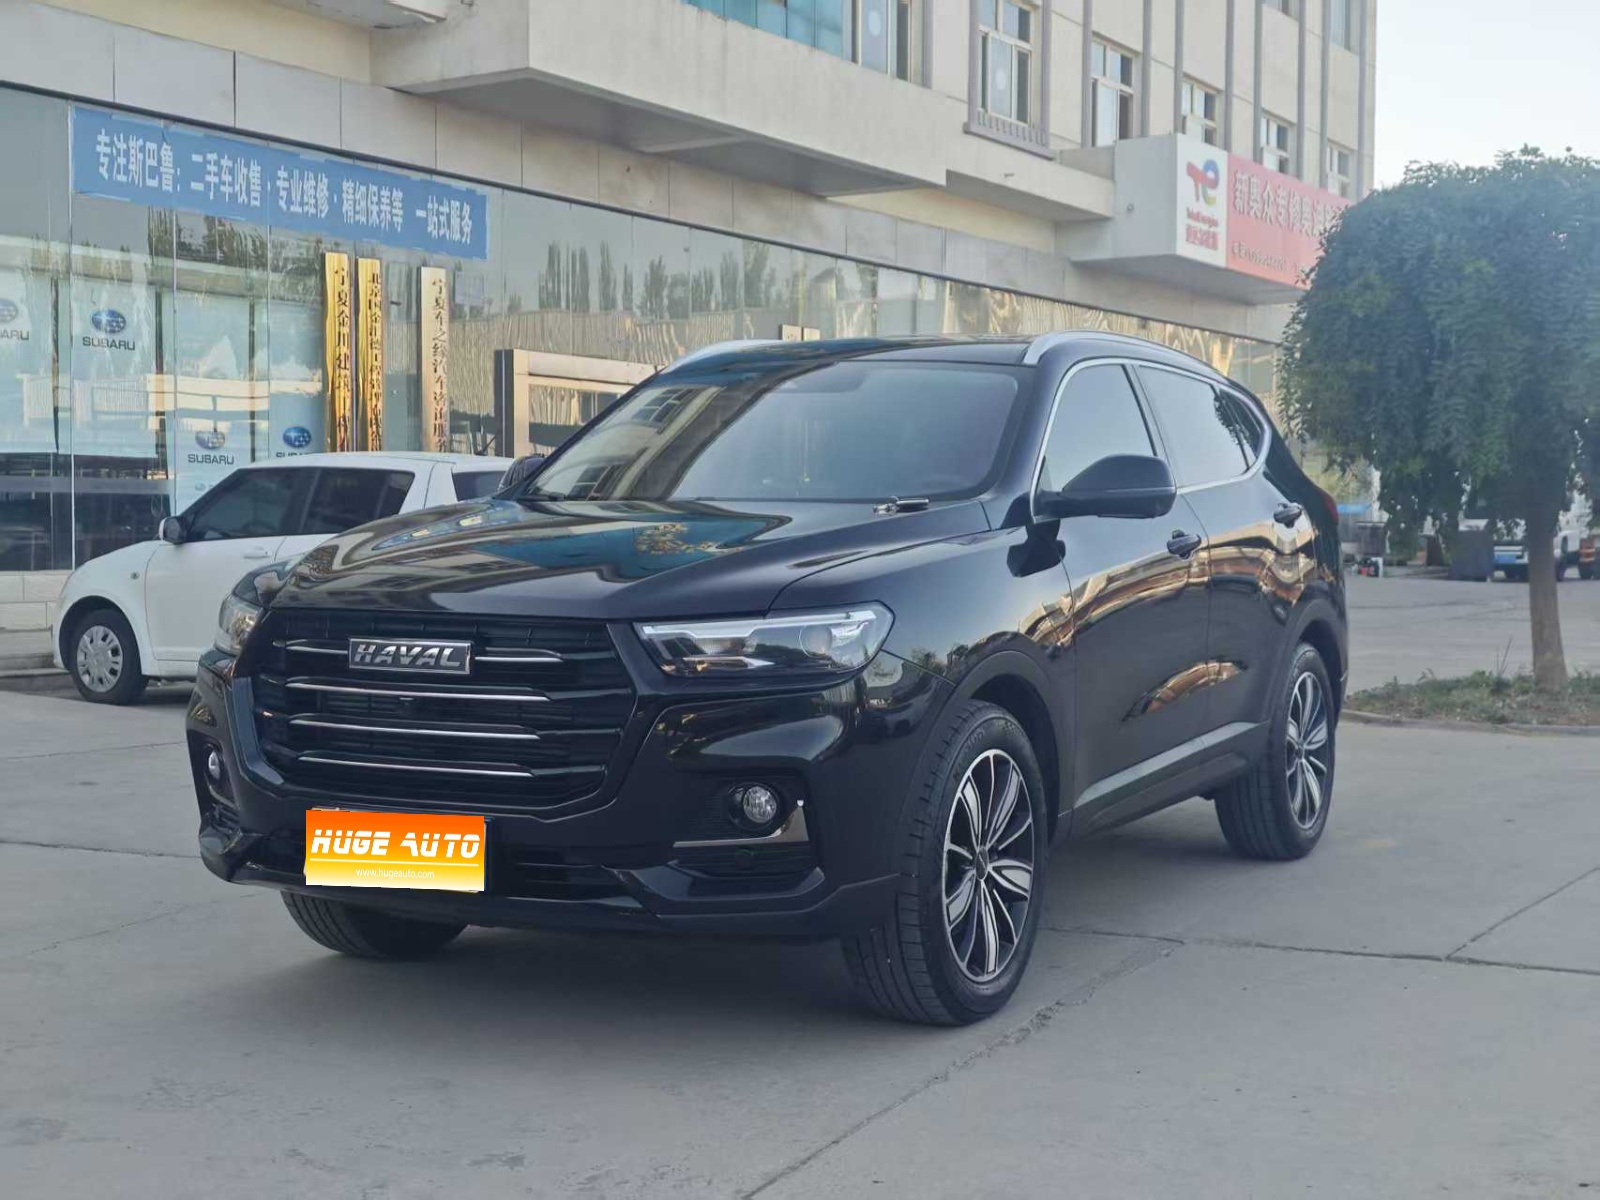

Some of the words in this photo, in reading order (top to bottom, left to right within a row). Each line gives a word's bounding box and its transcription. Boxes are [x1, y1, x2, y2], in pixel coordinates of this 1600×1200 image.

[415, 194, 473, 245] 一站式服务
[0, 329, 29, 341] ARU
[82, 336, 136, 351] SUBARU
[187, 453, 235, 465] SUBARU
[353, 644, 462, 667] HAVAL
